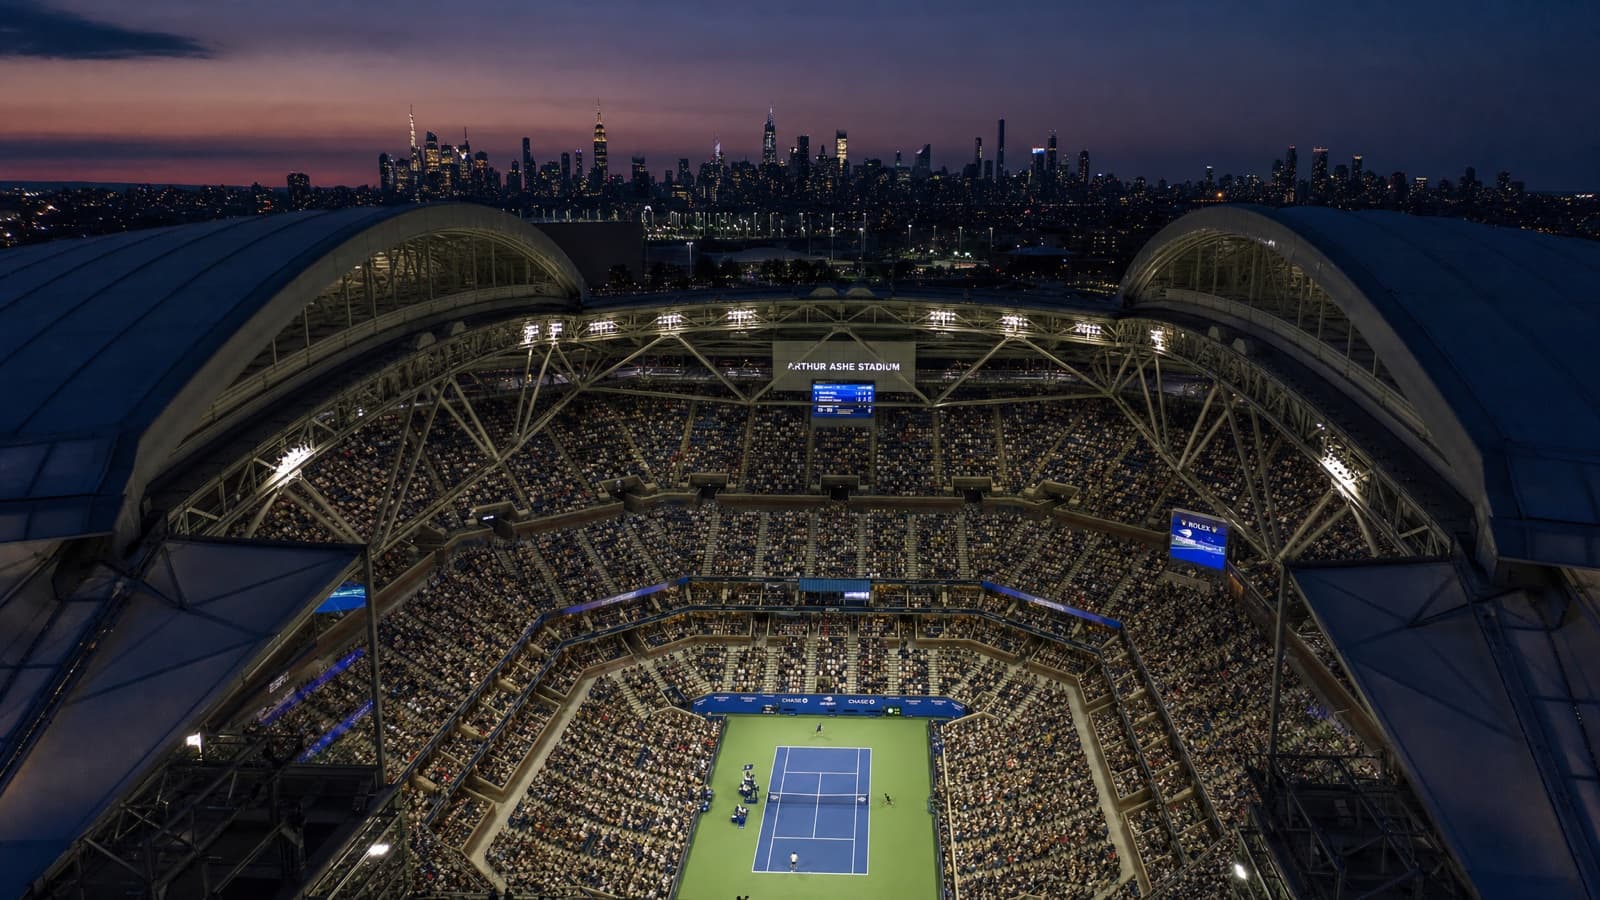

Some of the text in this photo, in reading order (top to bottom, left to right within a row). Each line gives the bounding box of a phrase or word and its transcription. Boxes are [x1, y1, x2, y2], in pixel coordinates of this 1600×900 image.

[788, 362, 900, 371] ARTHUR ASHE STADIUM
[1188, 521, 1211, 532] ROLEX
